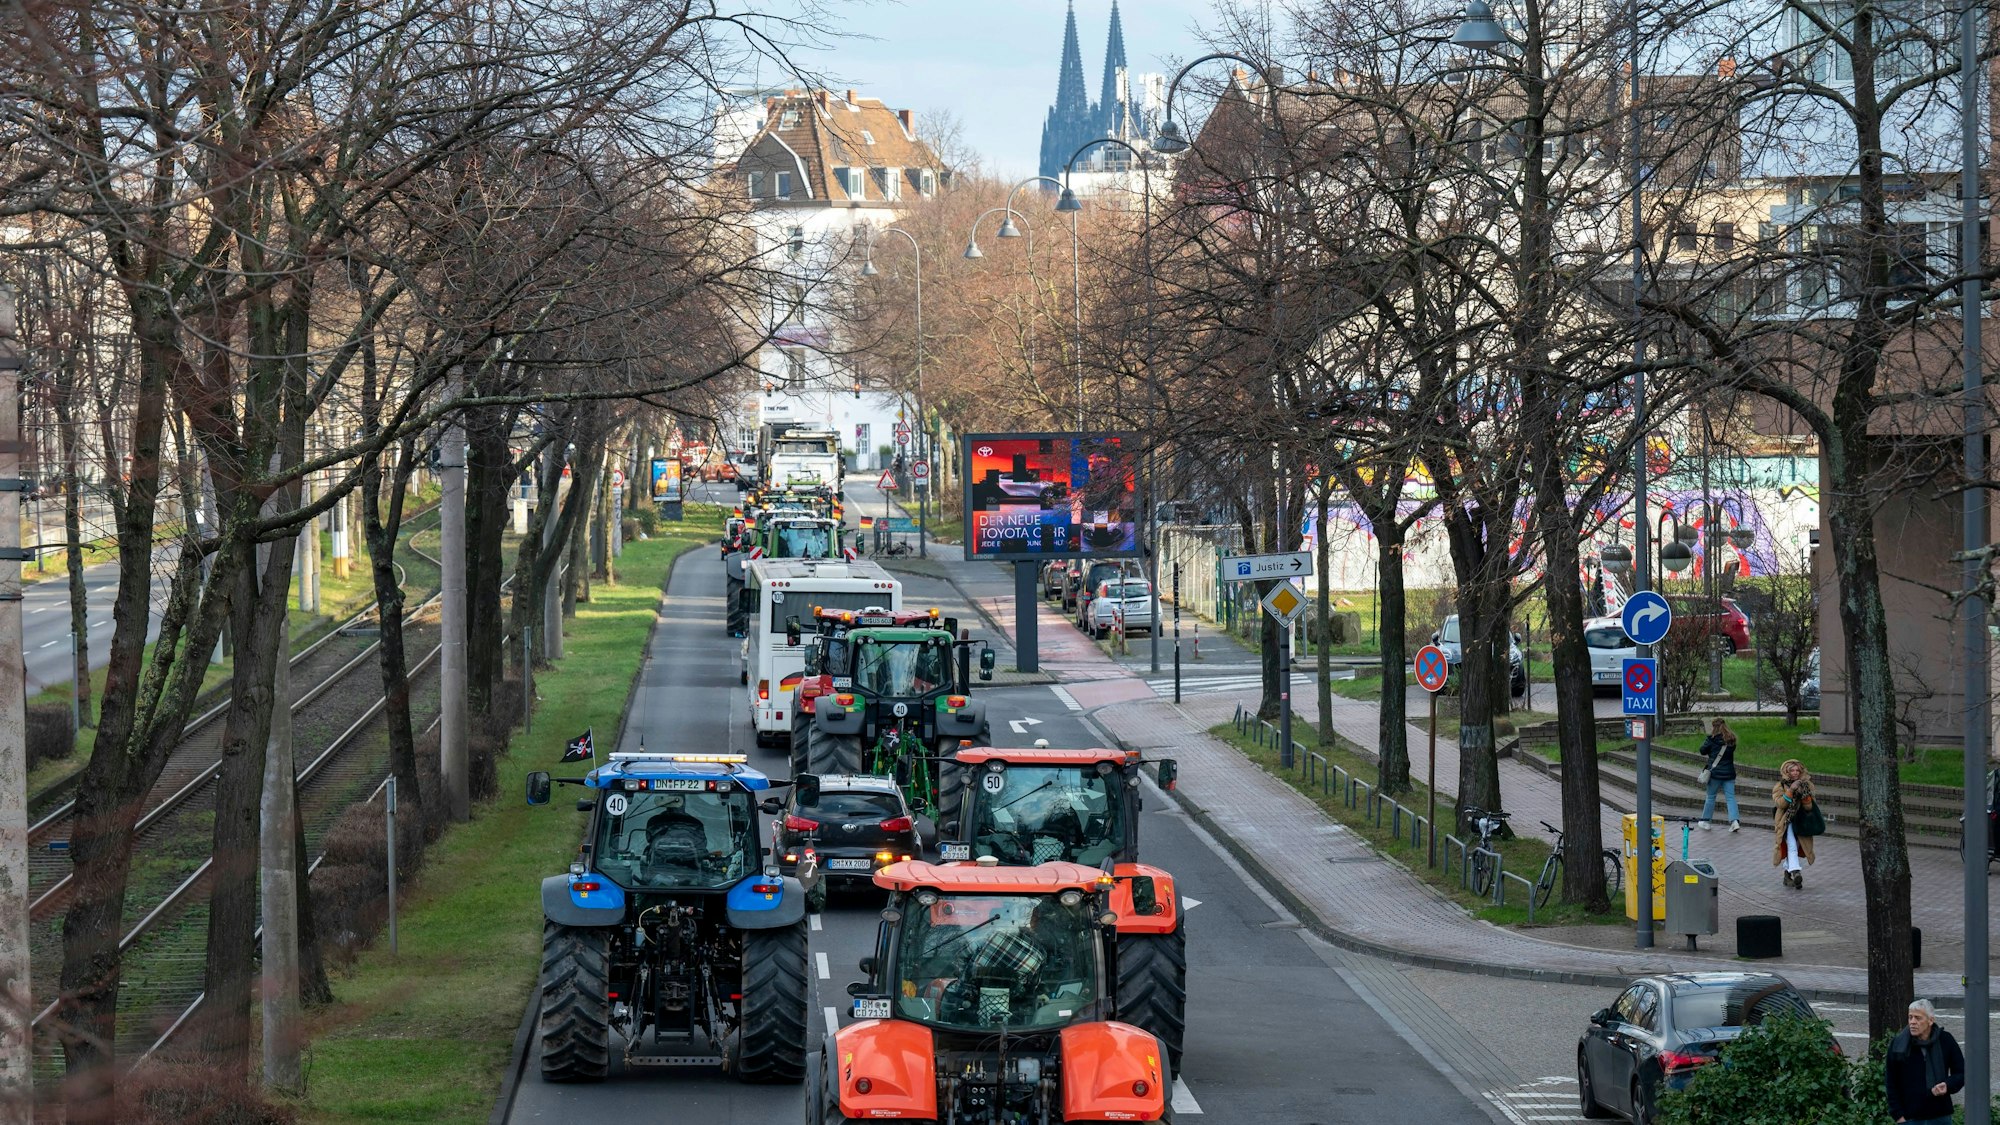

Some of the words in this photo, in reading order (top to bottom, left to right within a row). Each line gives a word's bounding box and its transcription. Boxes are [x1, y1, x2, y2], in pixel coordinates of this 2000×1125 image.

[980, 516, 1004, 526] DER
[1008, 515, 1040, 526] NEUE
[981, 528, 1029, 538] TOYOTA
[1256, 562, 1284, 572] Justiz
[774, 593, 784, 602] 100
[1626, 697, 1652, 709] TAXI
[896, 704, 904, 713] 40
[656, 779, 668, 788] DN
[674, 780, 686, 788] FP
[688, 780, 699, 788] 22
[987, 776, 1000, 788] 50
[610, 798, 624, 812] 40
[845, 860, 852, 868] XX
[854, 860, 870, 868] 2006
